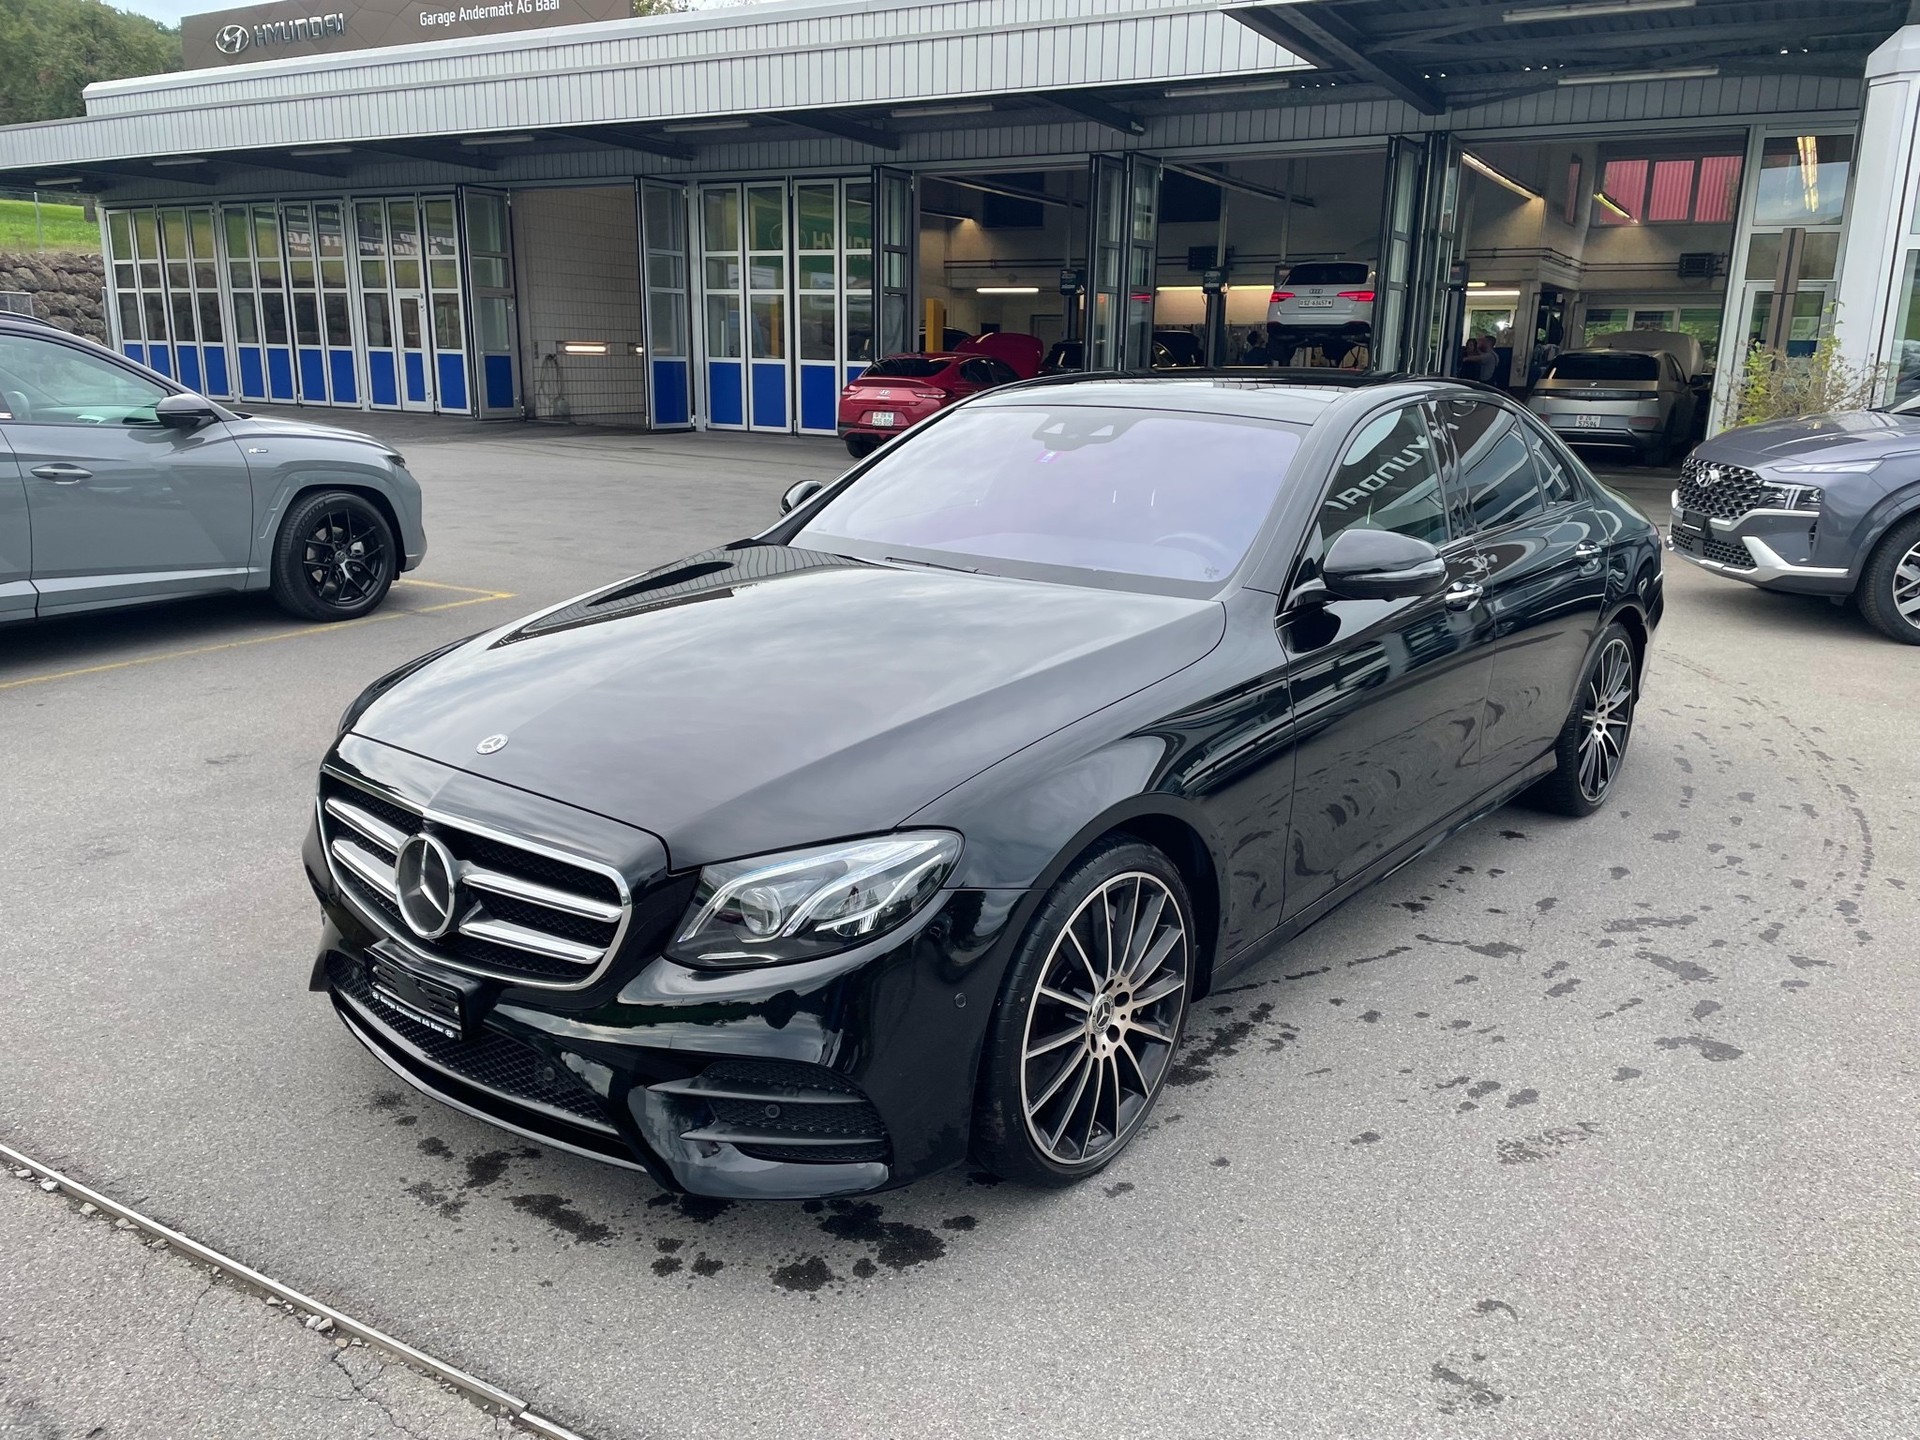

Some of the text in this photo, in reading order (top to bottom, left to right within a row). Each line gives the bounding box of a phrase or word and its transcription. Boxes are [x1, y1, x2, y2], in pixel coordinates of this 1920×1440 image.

[419, 11, 456, 27] Garage
[458, 5, 513, 21] Andermatt
[516, 0, 533, 13] AG
[253, 12, 345, 47] HYUNDAI
